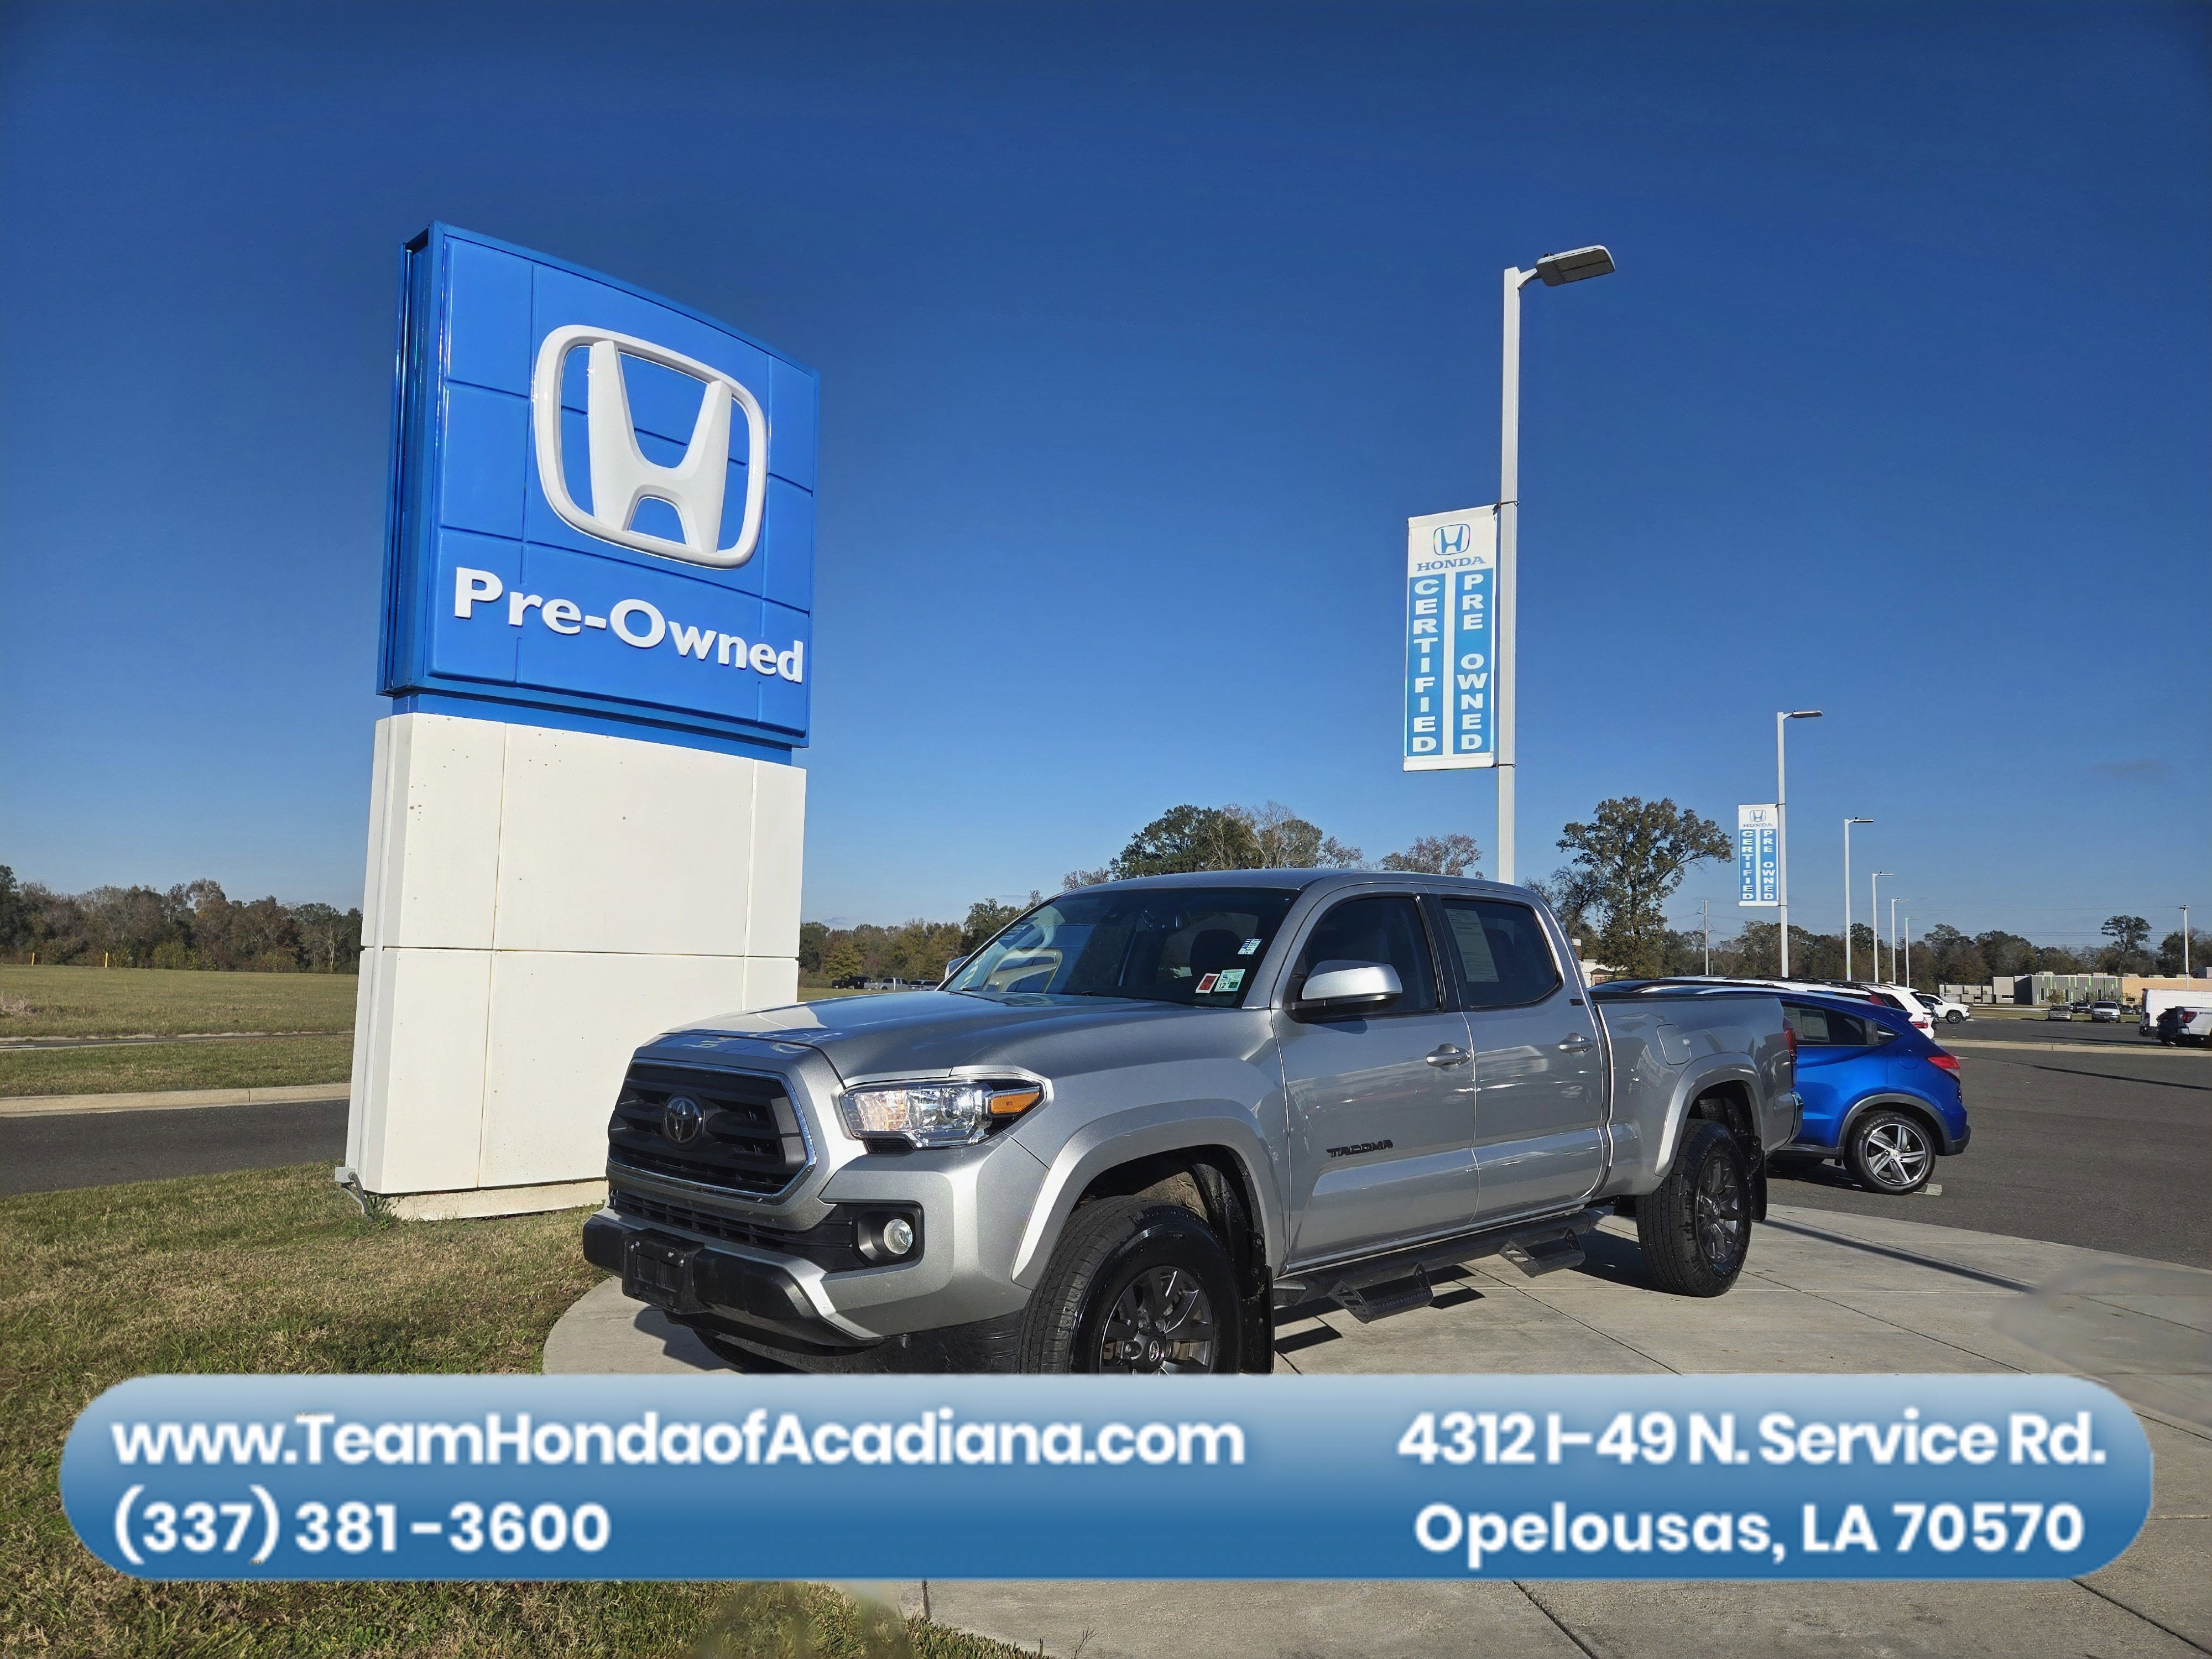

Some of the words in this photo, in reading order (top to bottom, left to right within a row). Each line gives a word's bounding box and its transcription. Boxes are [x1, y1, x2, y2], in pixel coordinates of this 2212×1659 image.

[1416, 556, 1486, 572] HONDA
[453, 566, 804, 684] Pre-Owned
[1462, 573, 1484, 630] PRE
[1412, 578, 1440, 753] CERTIFIED
[1457, 653, 1488, 751] OWNED
[1741, 830, 1754, 900] CERTIFIED
[1762, 830, 1773, 853] PRE
[1761, 861, 1776, 900] OWNED
[1326, 1139, 1394, 1158] TACOMA
